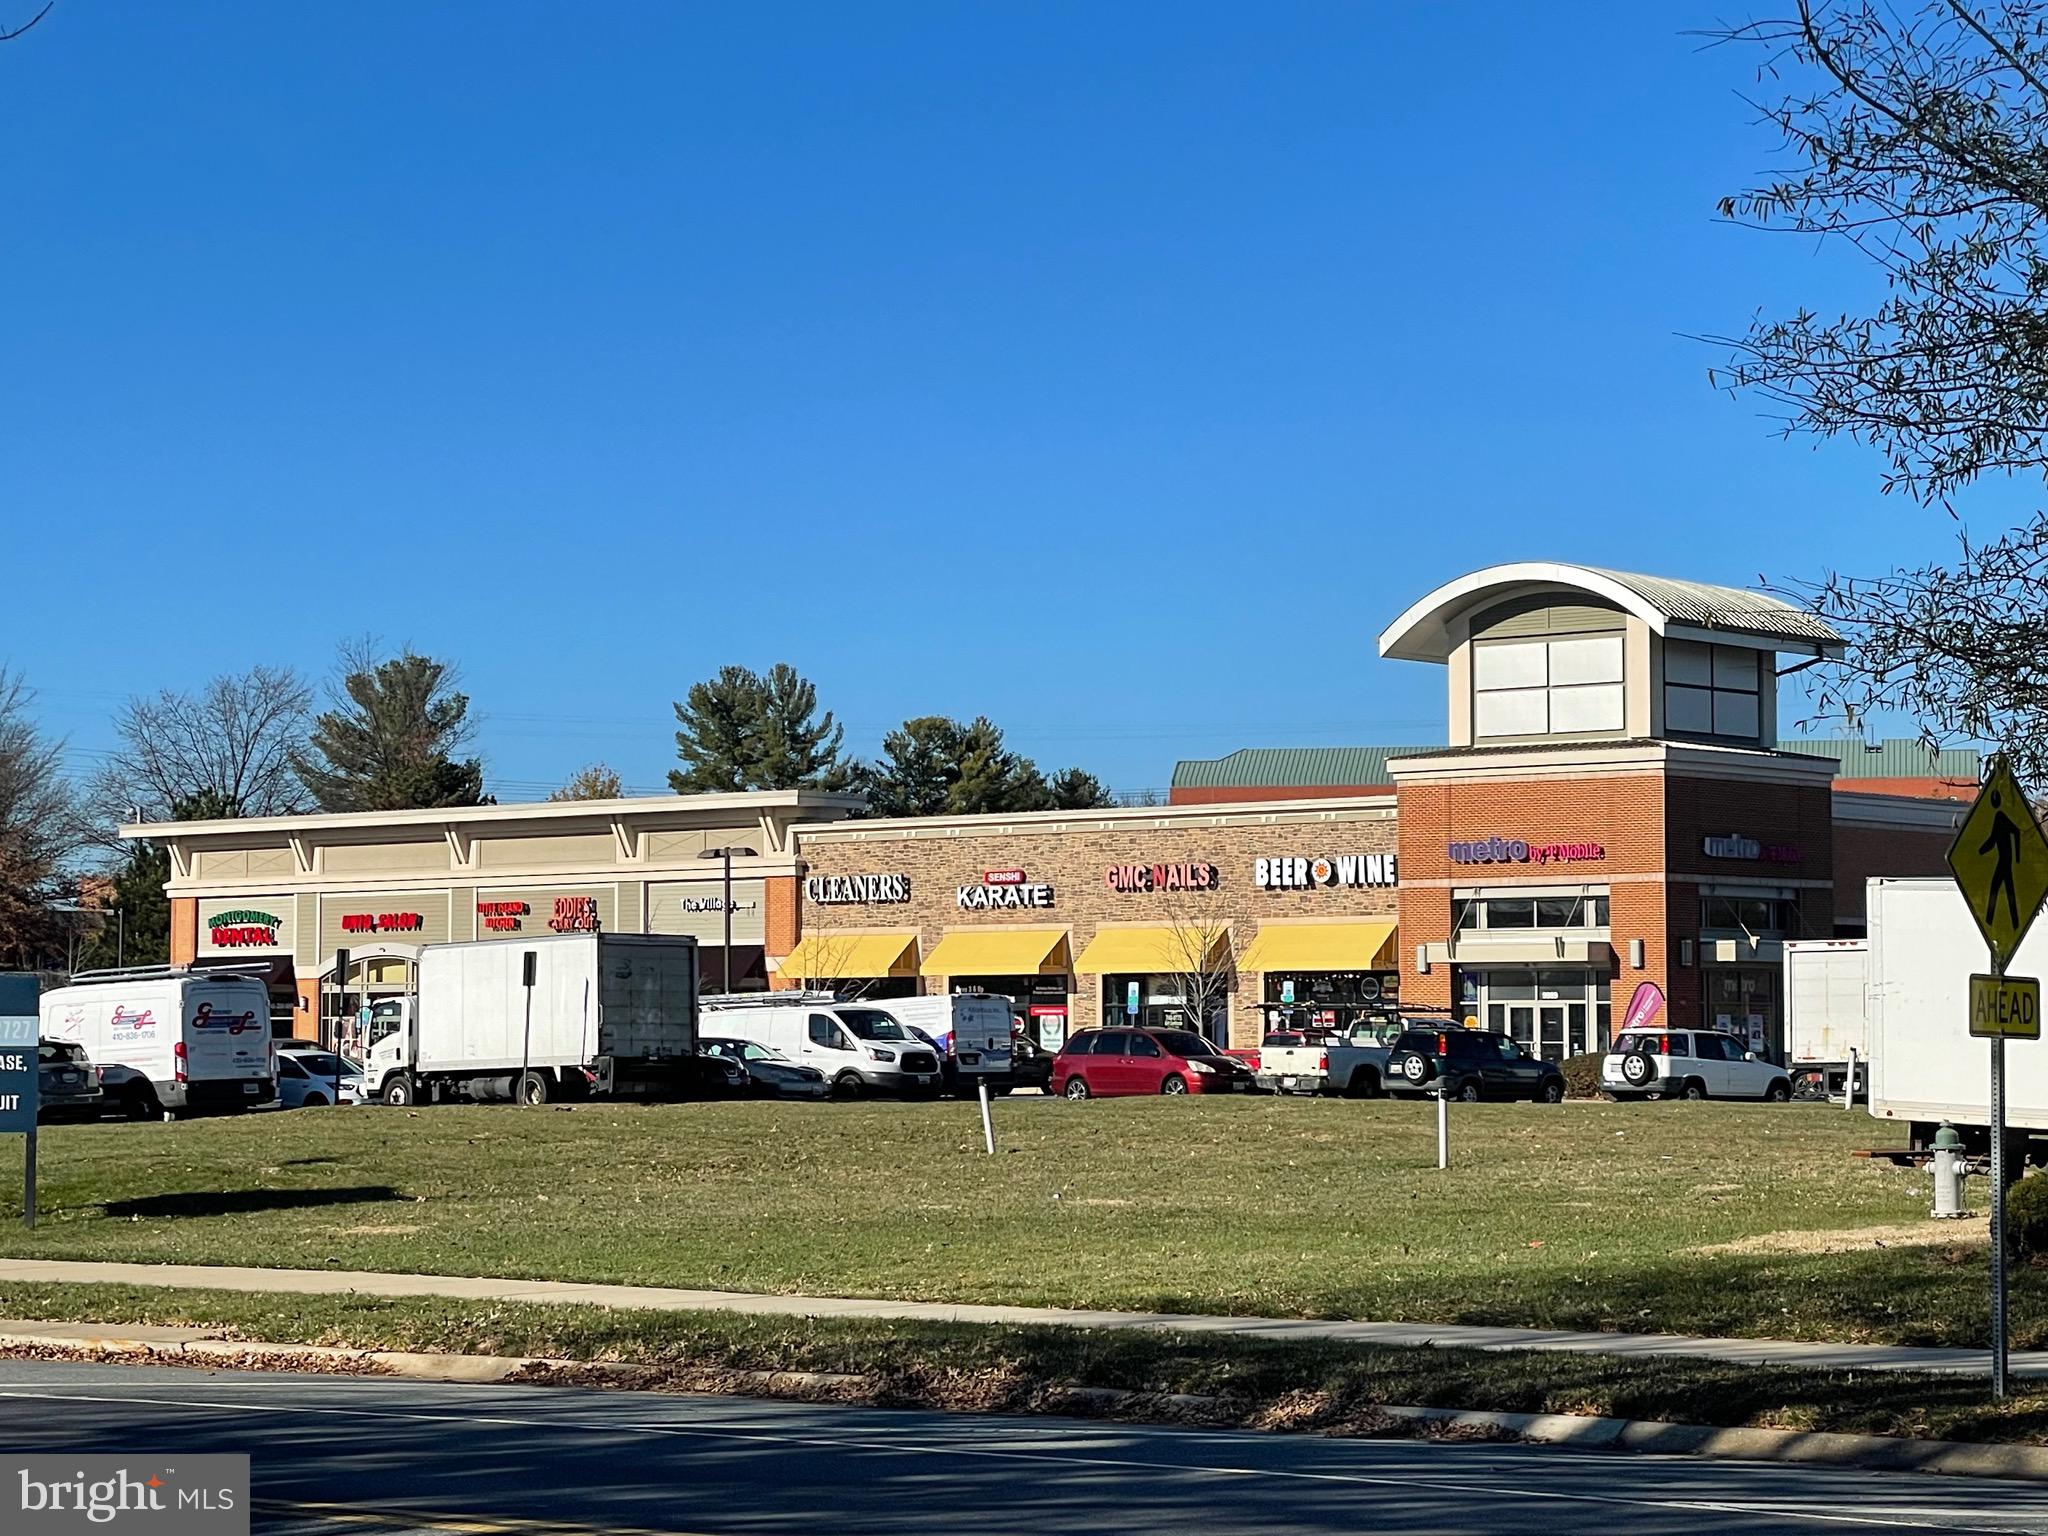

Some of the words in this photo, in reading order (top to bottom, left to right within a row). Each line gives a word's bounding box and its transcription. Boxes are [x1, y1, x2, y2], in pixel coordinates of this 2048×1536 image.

[1448, 836, 1528, 862] metro
[988, 871, 1020, 882] SENSHI
[1105, 865, 1147, 889] GMC
[1153, 863, 1210, 887] NAILS
[1255, 858, 1309, 887] BEER
[1336, 855, 1395, 885] WINE
[806, 874, 904, 903] CLEANERS
[957, 884, 1049, 907] KARATE
[208, 909, 280, 929] MONTGOMERY
[212, 927, 275, 945] DENTAL
[1976, 990, 2034, 1024] AHEAD
[0, 1020, 31, 1040] 727
